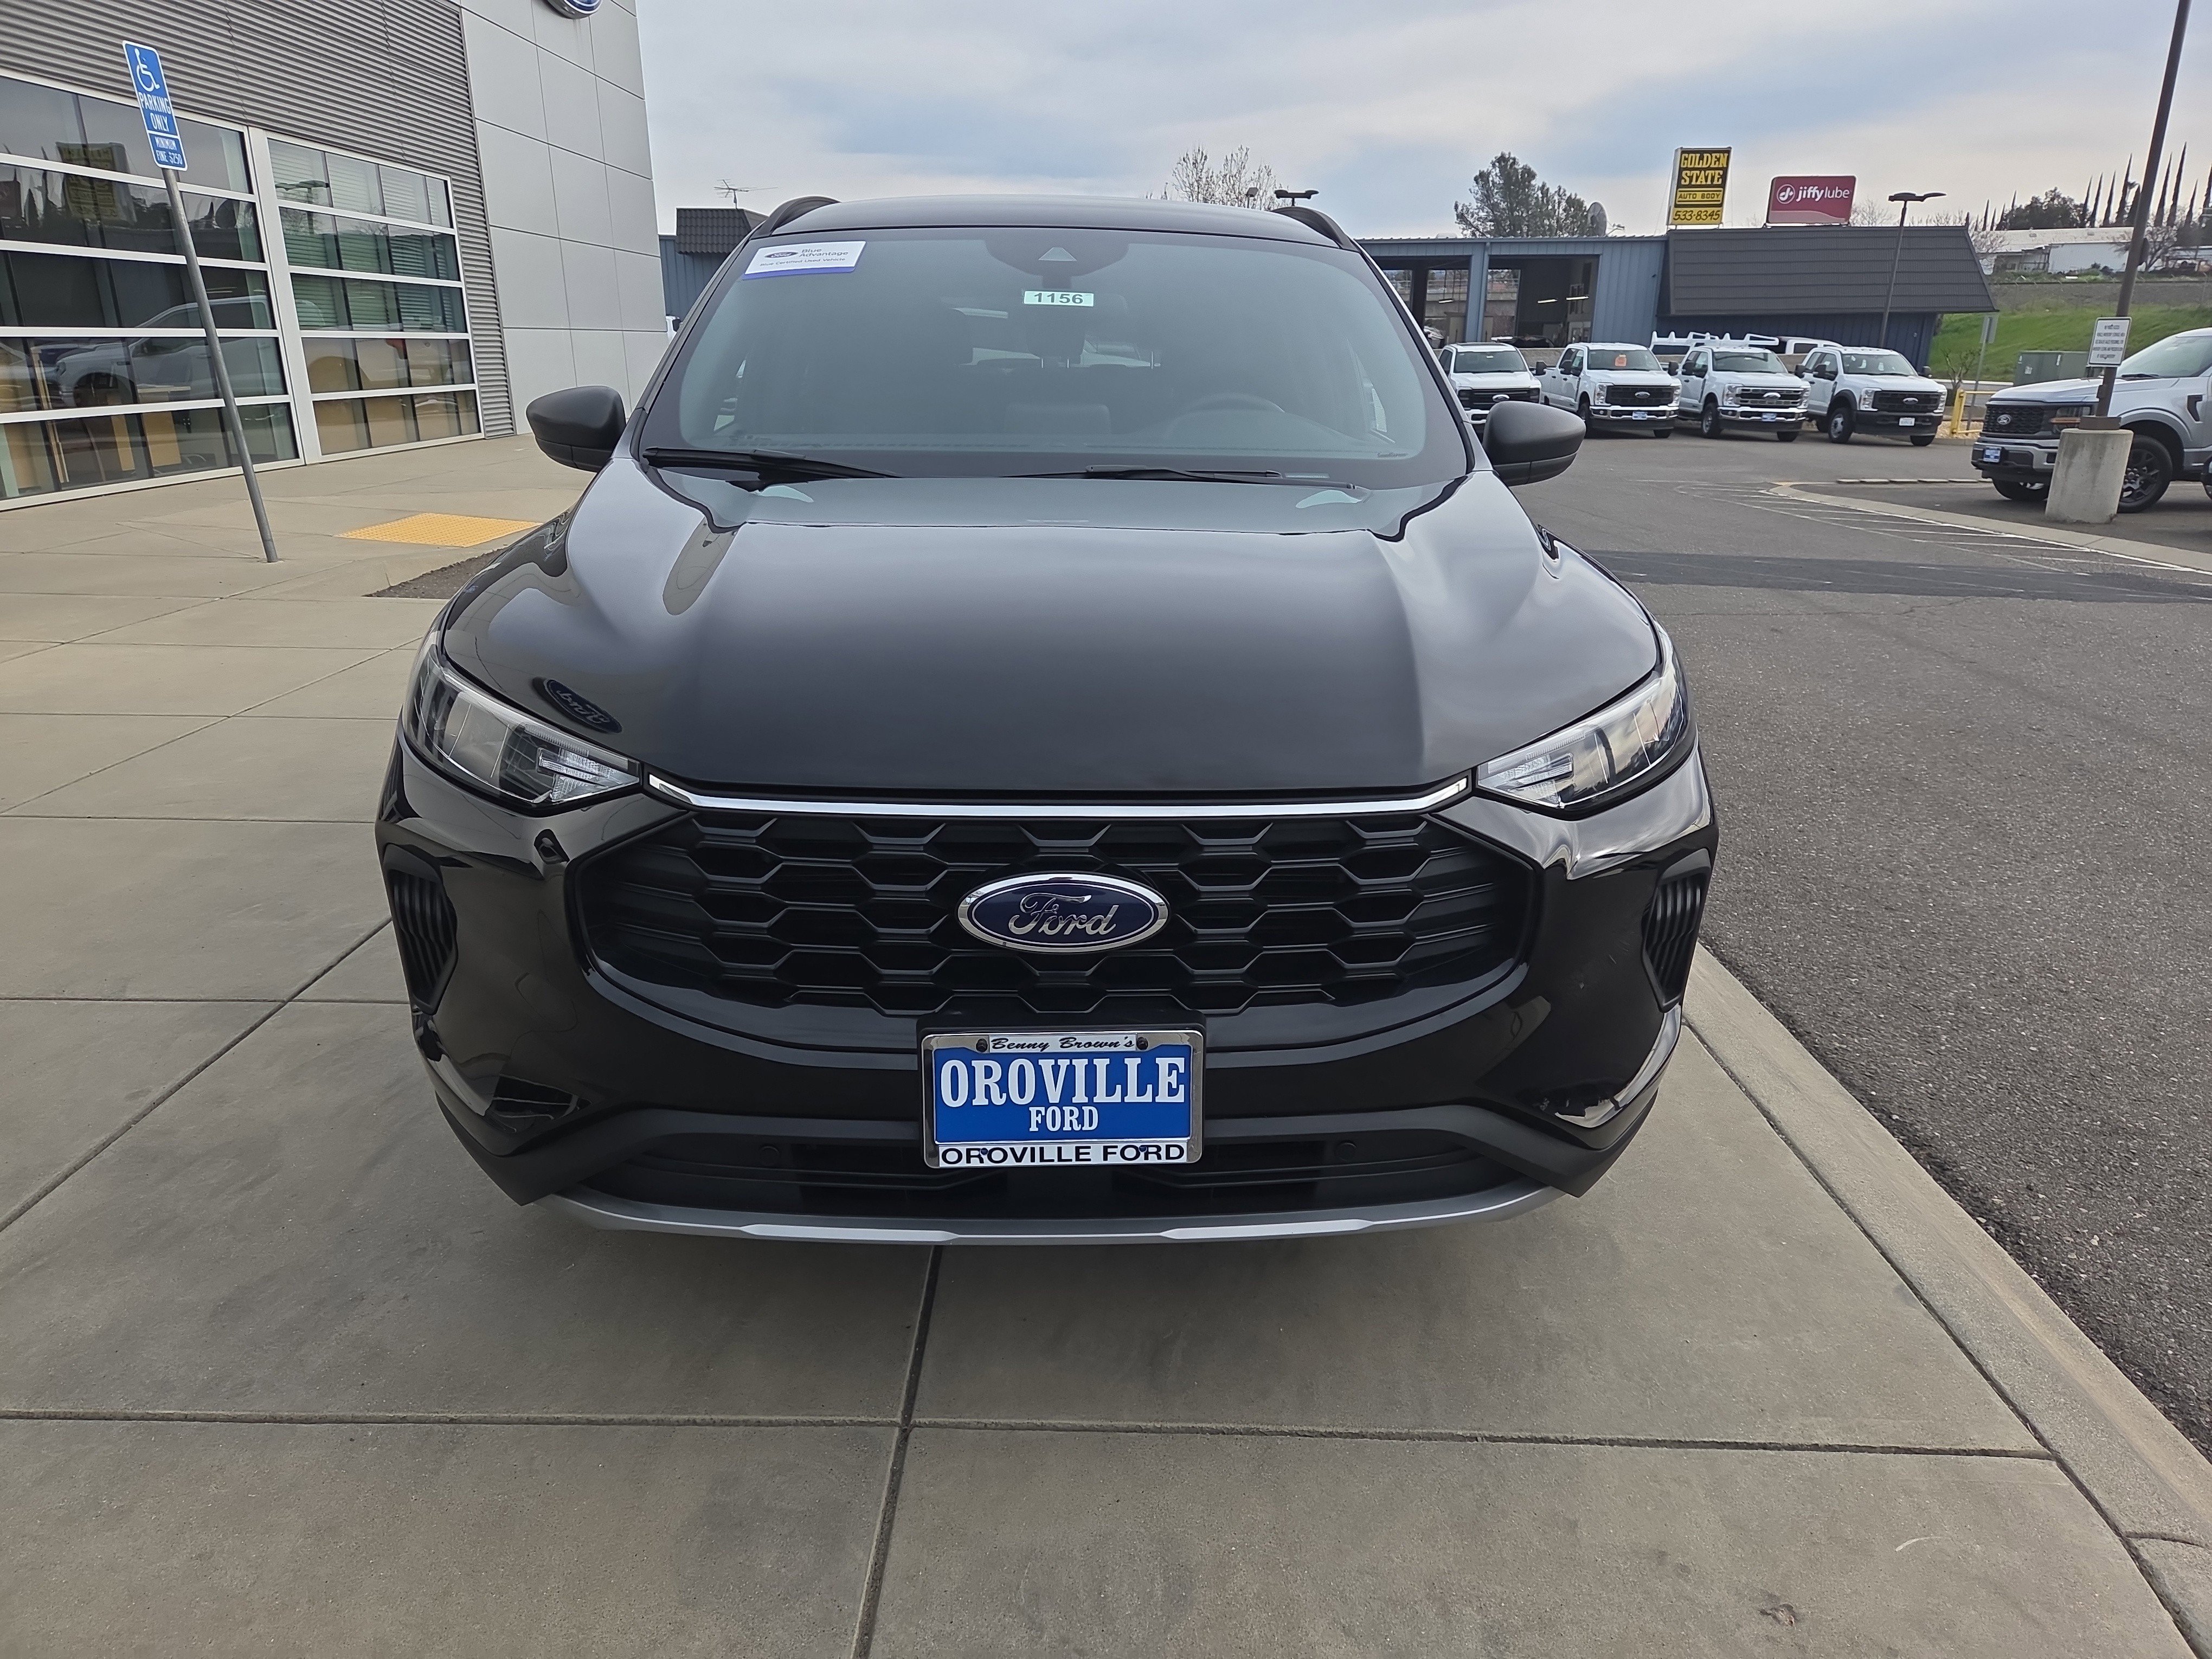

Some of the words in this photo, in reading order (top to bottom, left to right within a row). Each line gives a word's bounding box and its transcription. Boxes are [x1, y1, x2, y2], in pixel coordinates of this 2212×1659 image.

[138, 92, 171, 114] PARKING
[150, 112, 170, 132] ONLY
[1680, 153, 1729, 168] GOLDEN
[1681, 170, 1724, 185] STATE
[1034, 292, 1083, 304] 1156
[1008, 892, 1120, 935] Ford
[991, 1037, 1050, 1052] Benny
[1058, 1036, 1135, 1049] Brown's
[940, 1057, 1185, 1108] OROVILLE
[1029, 1106, 1099, 1131] FORD
[941, 1146, 1092, 1165] OROVILLE
[1102, 1144, 1185, 1162] FORD
